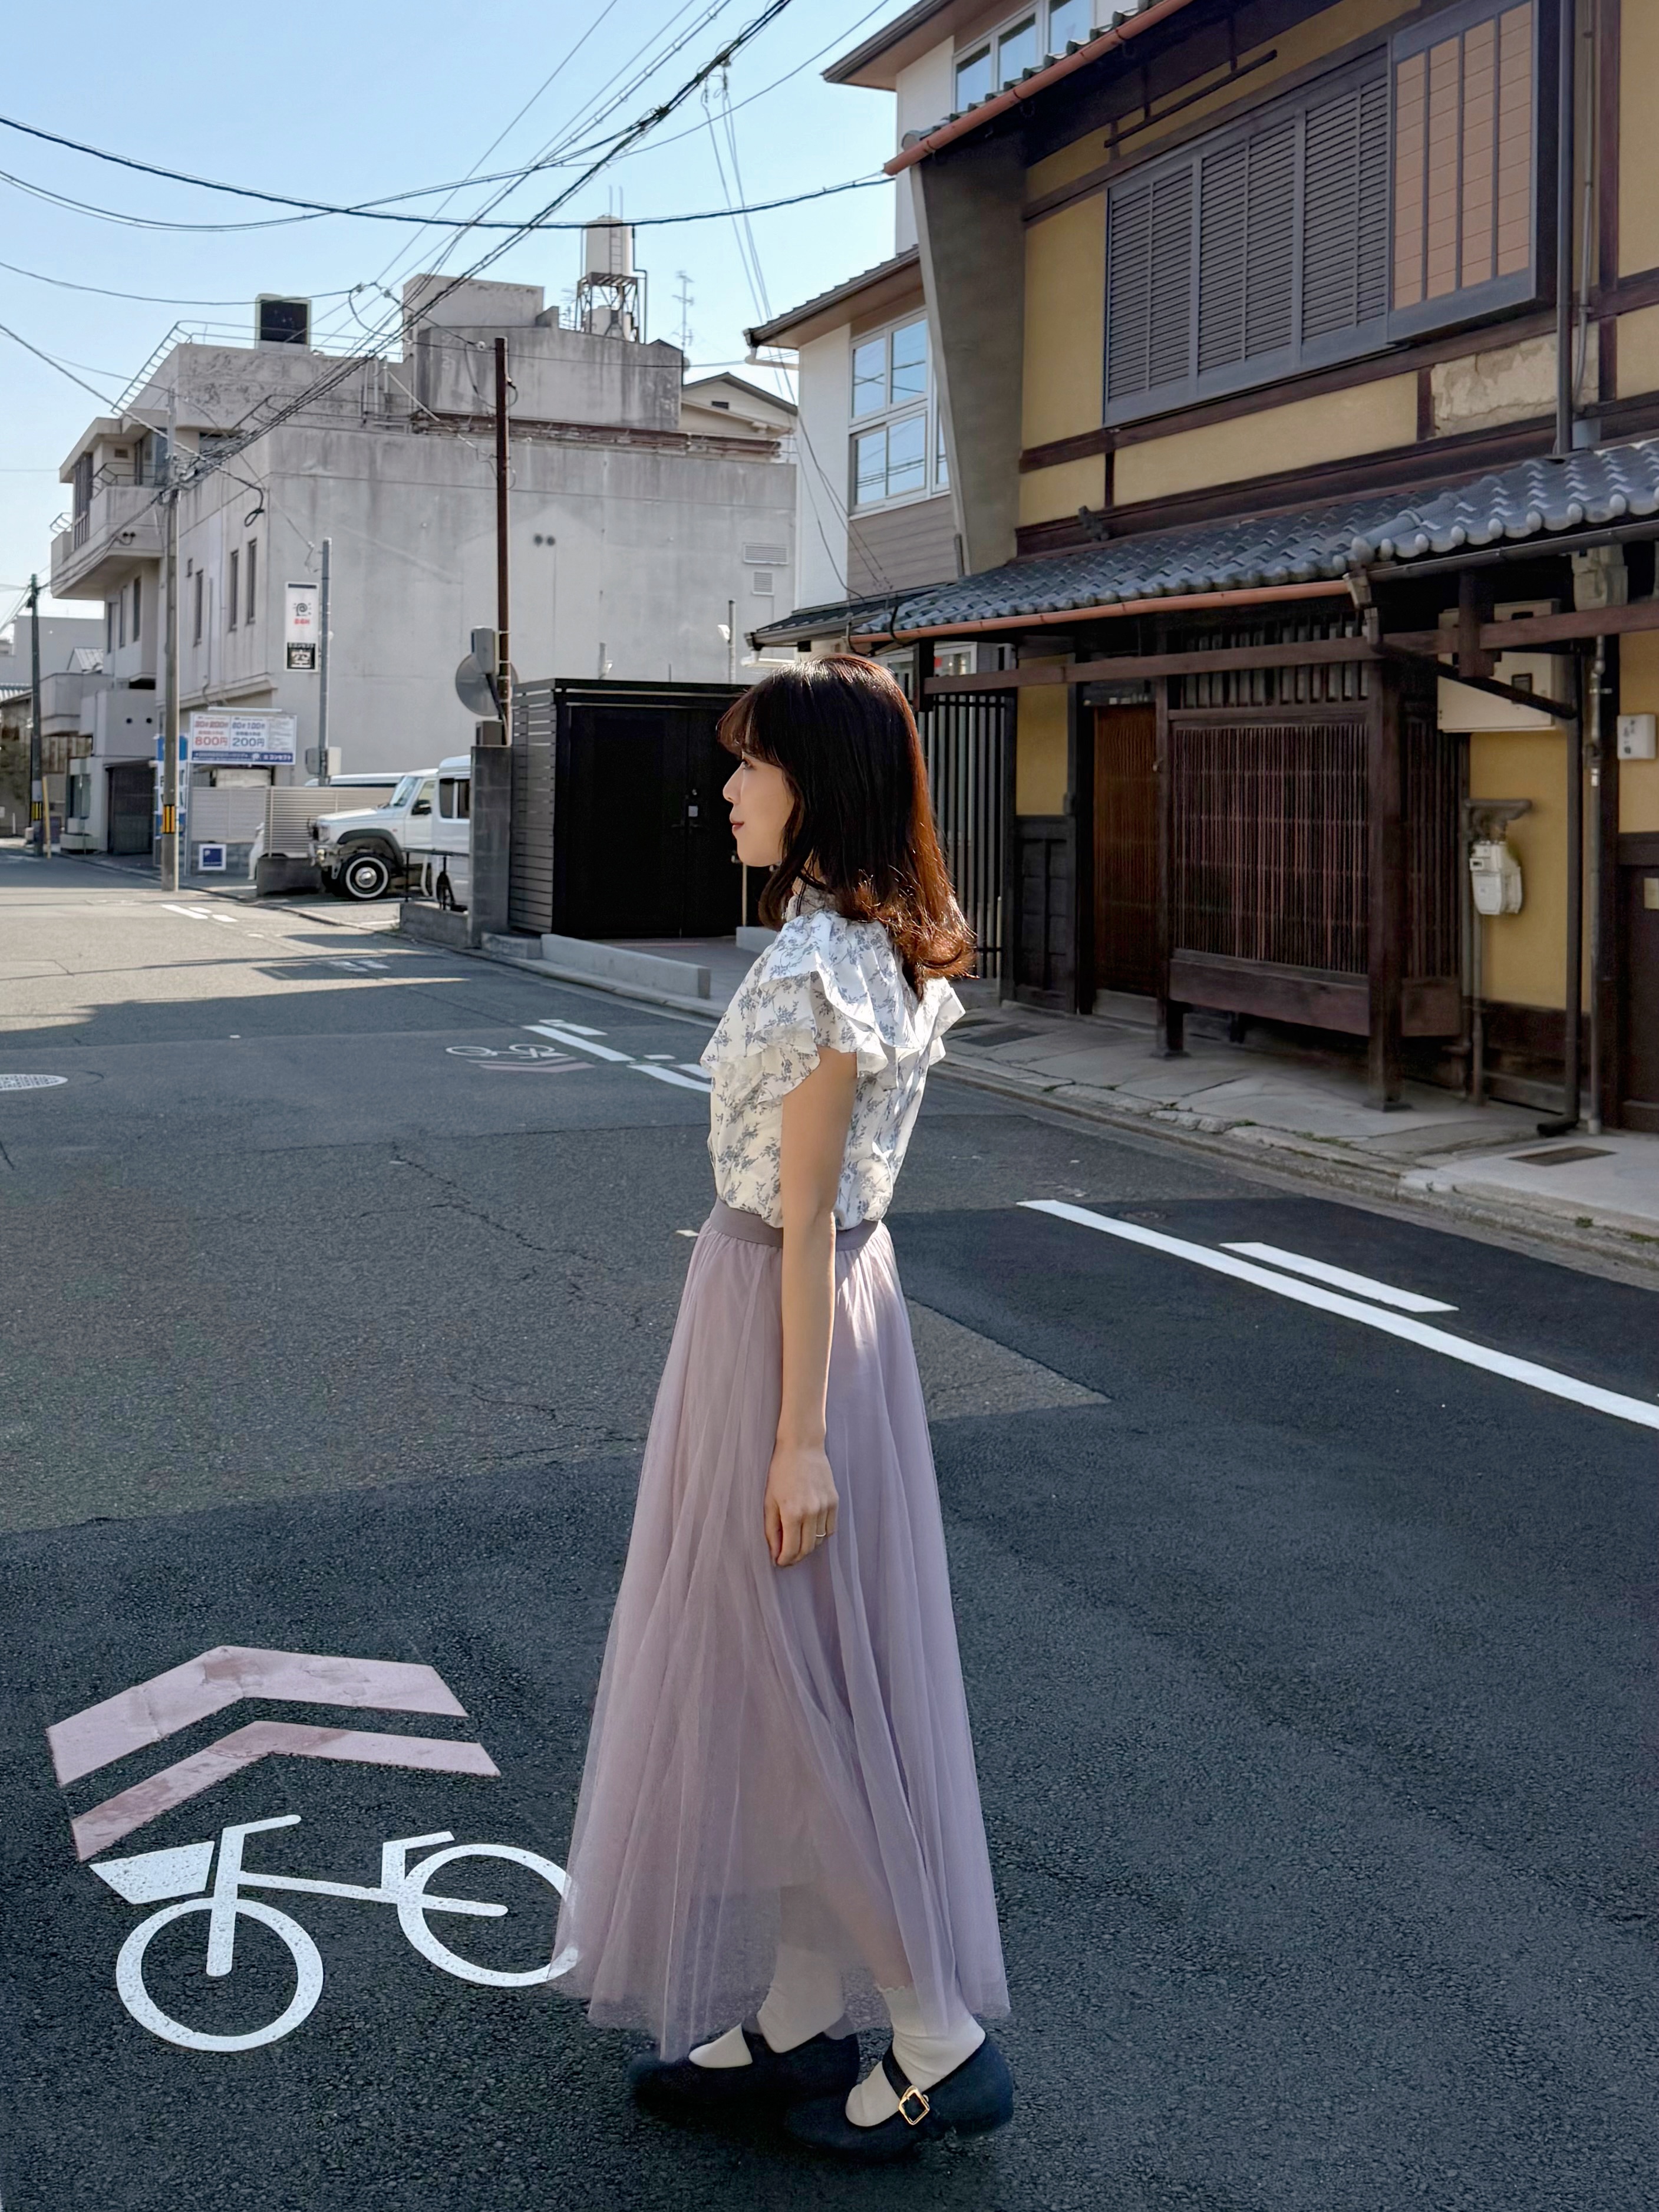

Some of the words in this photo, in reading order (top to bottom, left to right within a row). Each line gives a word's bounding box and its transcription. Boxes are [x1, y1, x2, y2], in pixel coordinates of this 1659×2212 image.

[291, 650, 311, 668] 空
[194, 736, 227, 746] 800円
[232, 737, 265, 747] 200円
